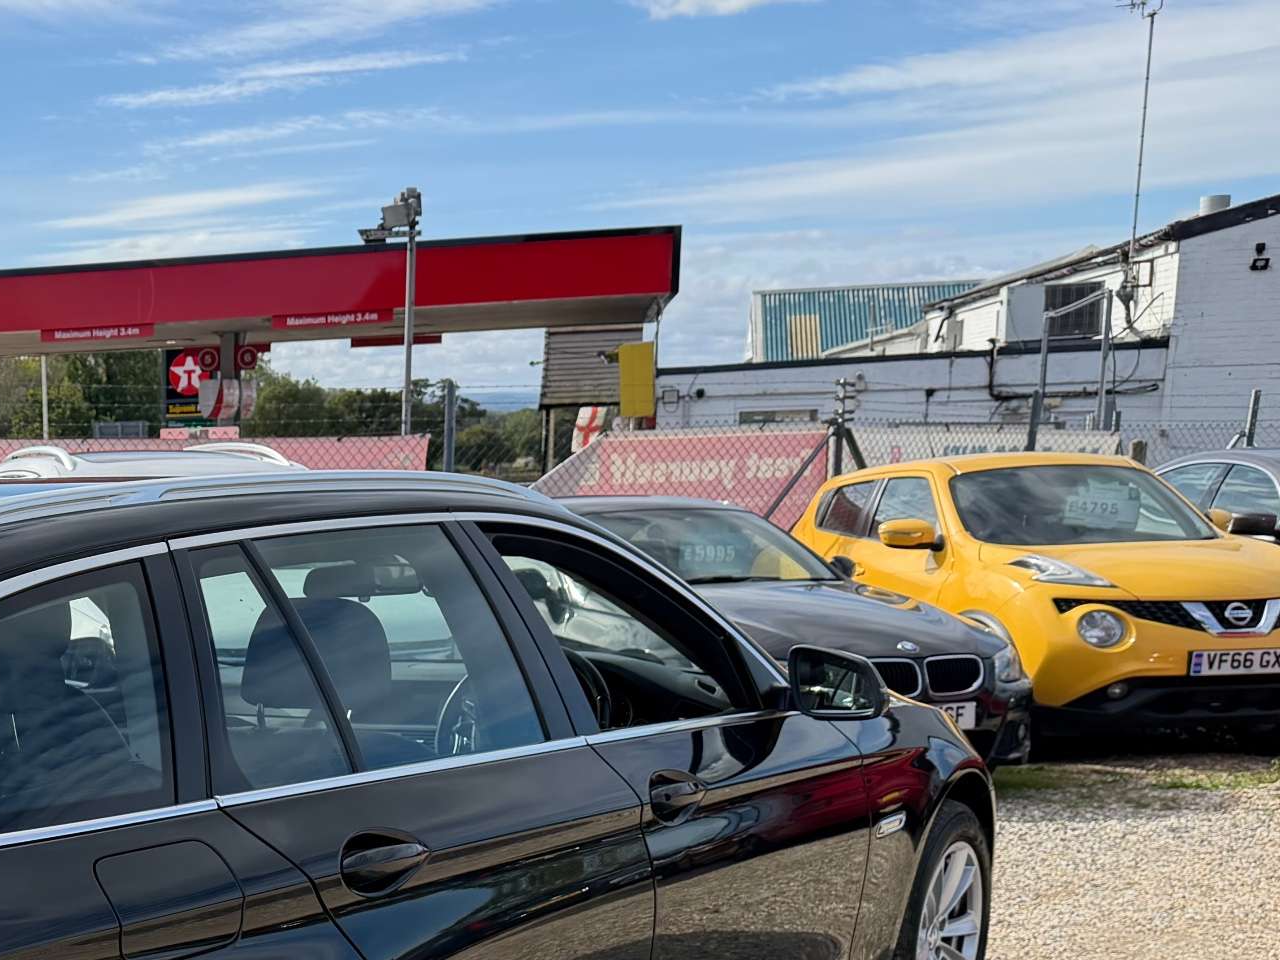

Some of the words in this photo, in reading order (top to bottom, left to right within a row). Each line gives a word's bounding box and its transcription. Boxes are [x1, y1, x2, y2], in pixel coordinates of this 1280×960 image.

[286, 315, 326, 325] Maximum
[327, 313, 355, 324] Height
[54, 329, 91, 339] Maximum
[93, 328, 118, 338] Height
[1207, 651, 1254, 670] VF66
